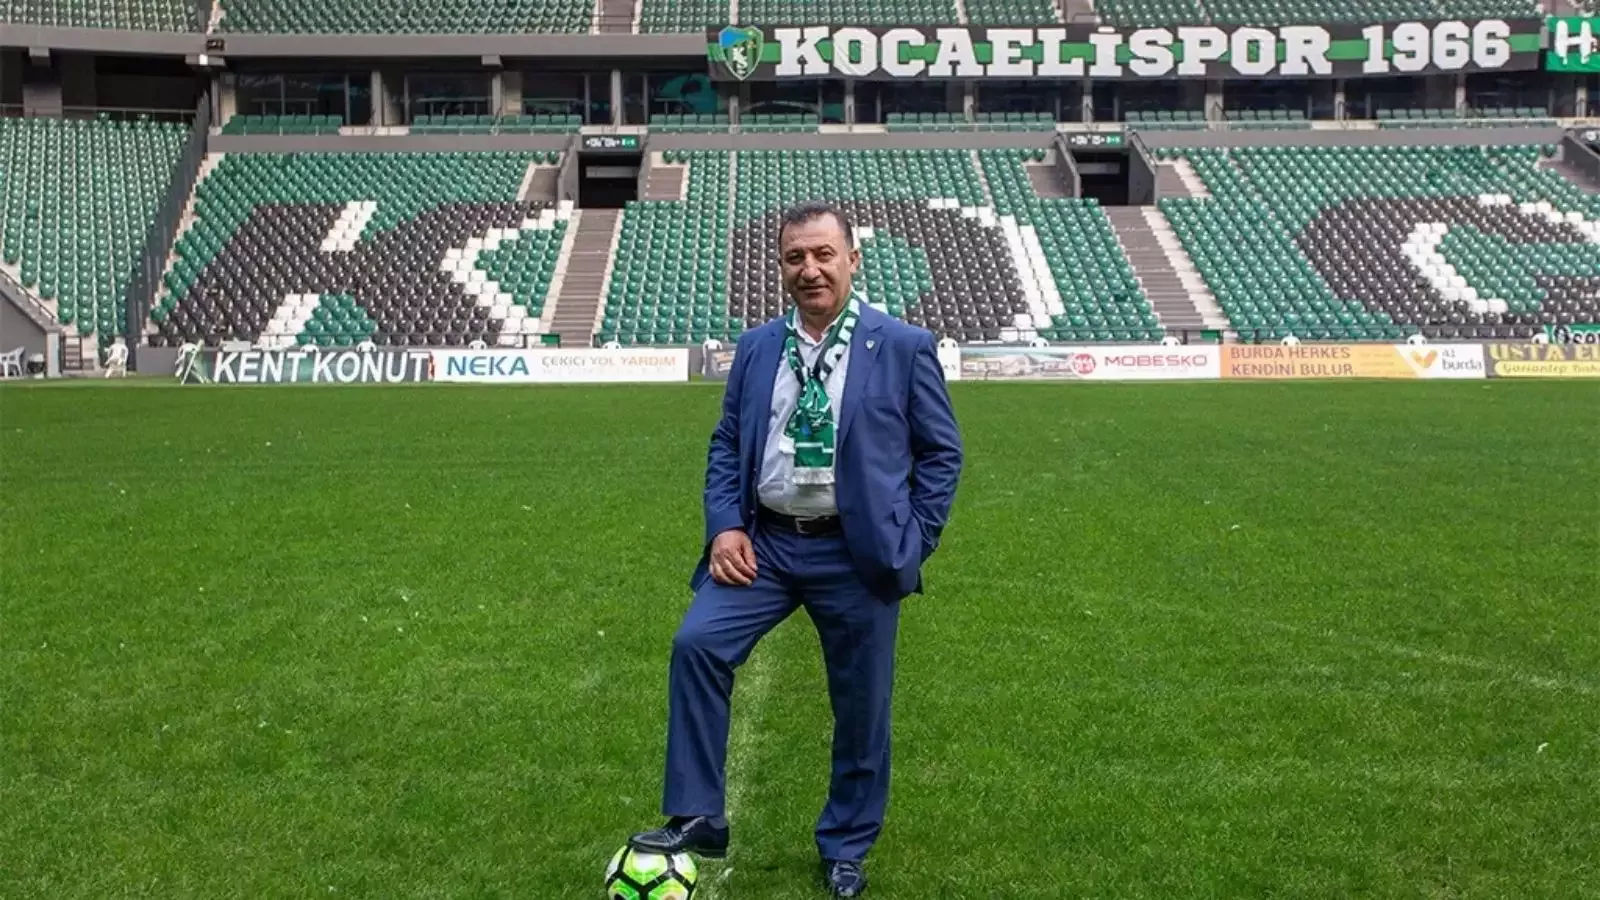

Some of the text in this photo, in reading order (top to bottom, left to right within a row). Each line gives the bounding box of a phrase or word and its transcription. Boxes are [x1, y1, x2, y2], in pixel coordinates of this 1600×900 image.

[774, 20, 1510, 77] KOCAELİSPOR 1966
[1104, 355, 1208, 367] MOBESKO
[1231, 347, 1284, 359] BURDA
[1289, 347, 1350, 359] HERKES
[213, 351, 429, 382] KENT KONUT
[446, 356, 529, 376] NEKA
